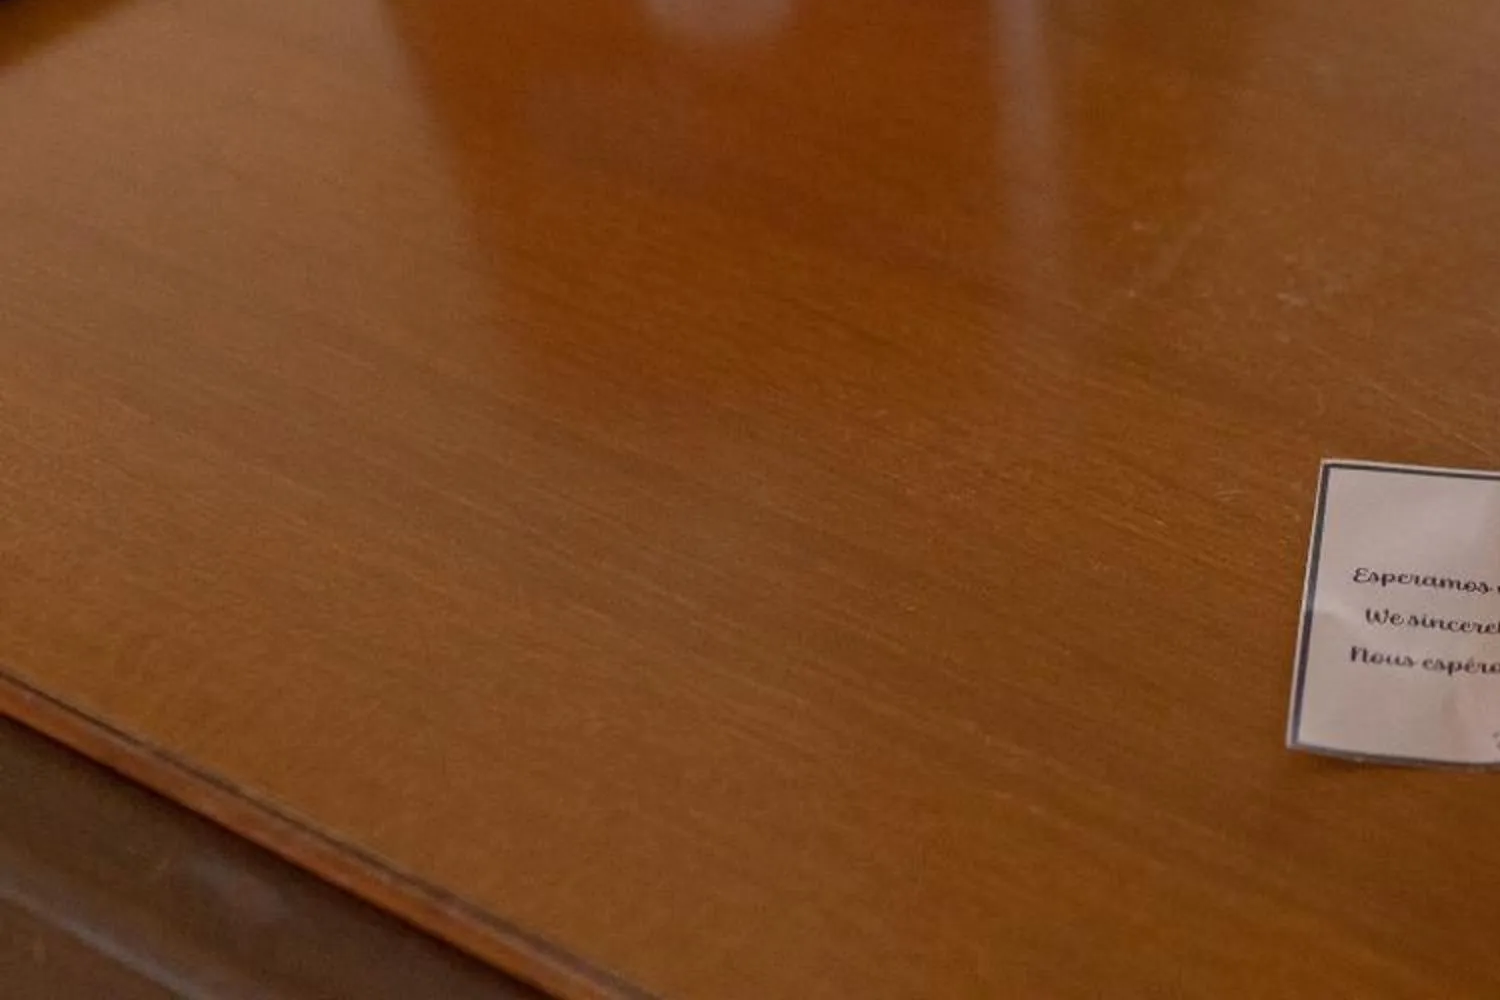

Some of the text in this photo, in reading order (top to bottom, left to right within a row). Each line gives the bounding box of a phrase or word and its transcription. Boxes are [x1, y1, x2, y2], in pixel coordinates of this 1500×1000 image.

[1353, 568, 1491, 594] Esperamos
[1365, 608, 1404, 626] We
[1350, 646, 1415, 668] Nous
